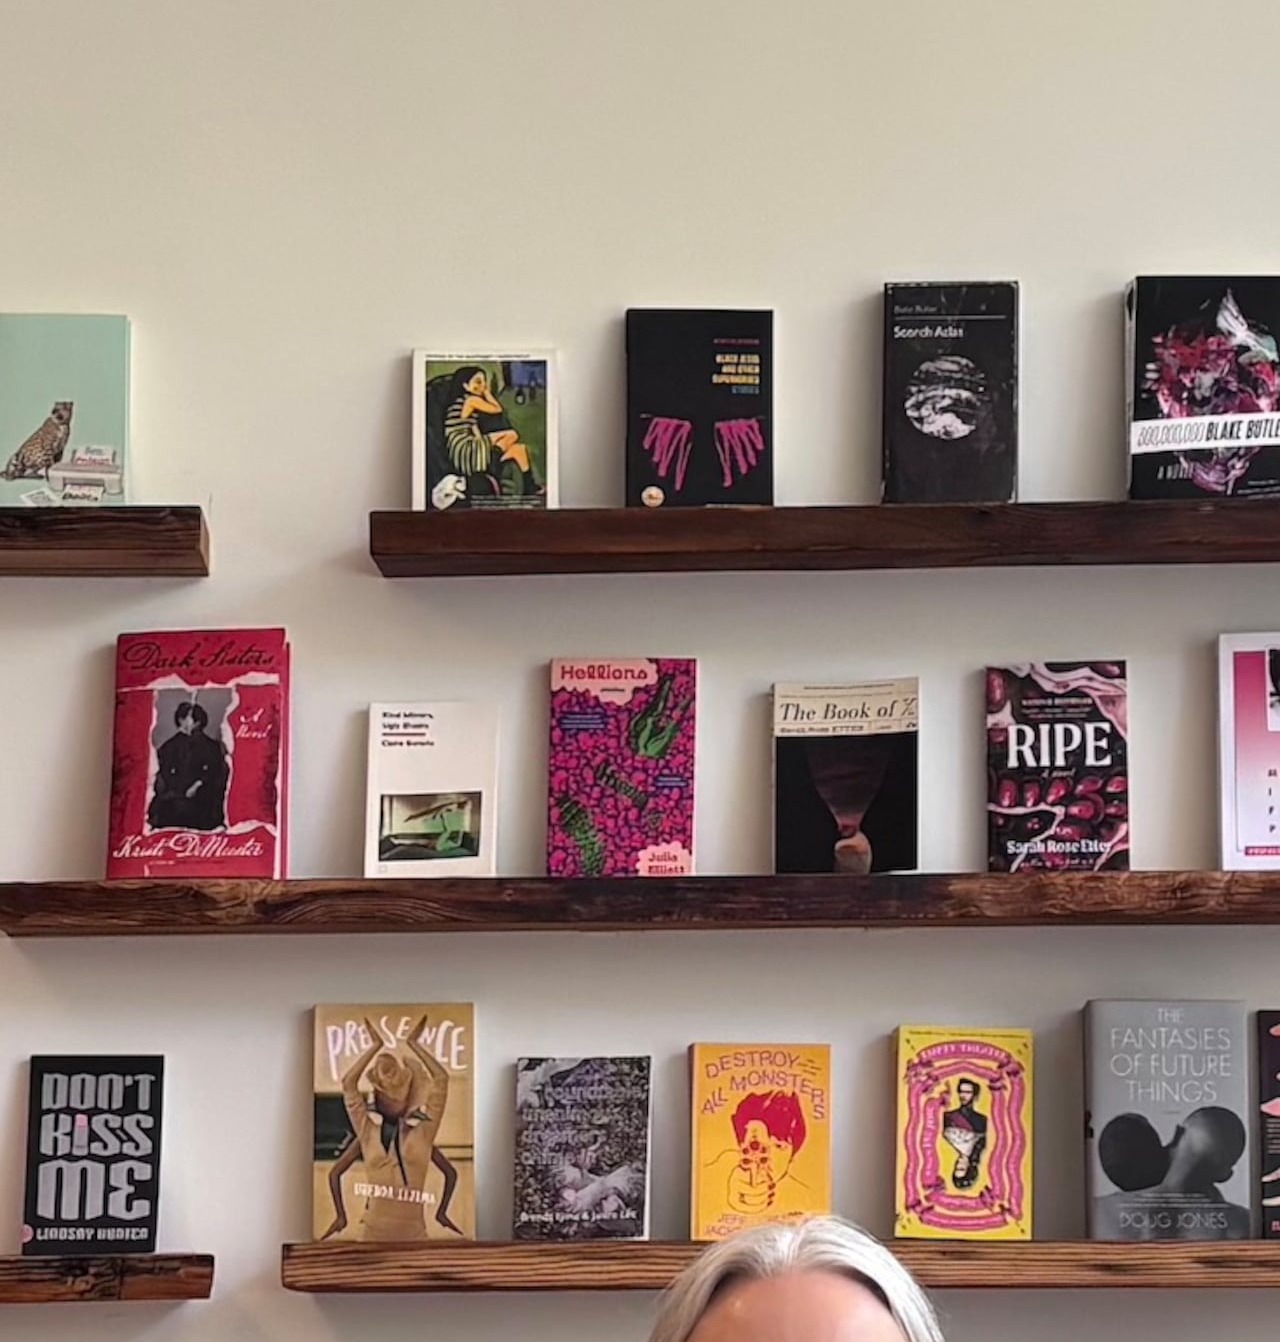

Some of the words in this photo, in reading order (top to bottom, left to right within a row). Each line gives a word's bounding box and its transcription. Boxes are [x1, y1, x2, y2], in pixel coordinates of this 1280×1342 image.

[894, 326, 933, 338] Scorch
[1205, 420, 1244, 441] BLAKE
[124, 641, 197, 671] Dark
[199, 644, 274, 669] Sisters
[560, 665, 648, 680] Hellions
[779, 703, 816, 721] The
[824, 701, 871, 719] Book
[877, 700, 898, 717] of
[1007, 722, 1112, 769] RIPE
[1006, 840, 1045, 854] Sarah
[1047, 841, 1080, 853] Rose
[1156, 1008, 1183, 1023] THE
[326, 1015, 468, 1081] PRESENCE
[1110, 1027, 1231, 1050] FANTASIES
[705, 1050, 800, 1079] DESTROY
[1110, 1054, 1146, 1077] OF
[1150, 1054, 1232, 1077] FUTURE
[41, 1073, 156, 1111] DON'T
[701, 1087, 728, 1115] ALL
[730, 1070, 825, 1120] MONSTERS
[1128, 1080, 1217, 1103] THINGS
[39, 1113, 154, 1157] KISS
[37, 1159, 152, 1221] ME
[1119, 1211, 1172, 1229] DOUG
[1175, 1211, 1228, 1229] JONES
[37, 1228, 94, 1241] LINDSAY
[97, 1228, 149, 1240] HUNTER
